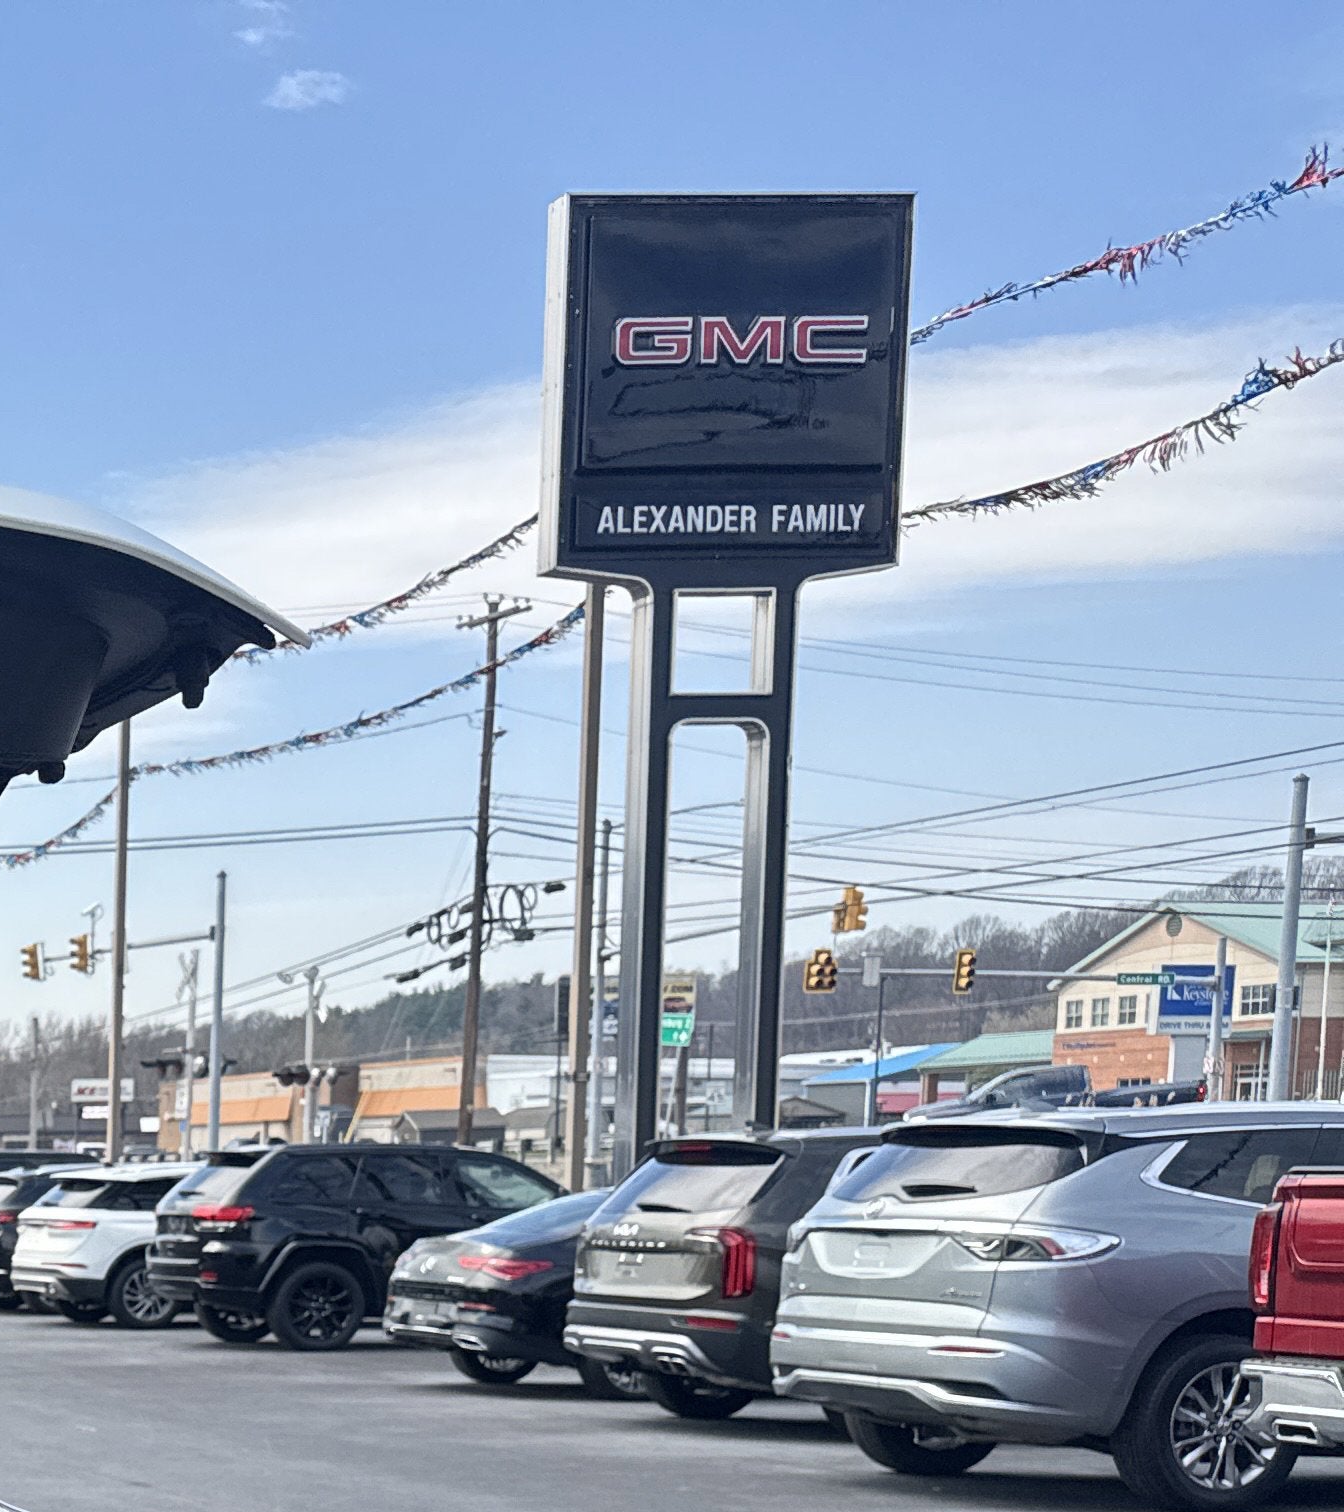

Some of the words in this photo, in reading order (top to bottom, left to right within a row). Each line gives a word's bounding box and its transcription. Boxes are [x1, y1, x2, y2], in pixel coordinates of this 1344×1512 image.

[614, 314, 869, 365] GMC
[596, 504, 757, 534] ALEXANDER
[771, 503, 866, 533] FAMILY
[1119, 973, 1153, 984] Central
